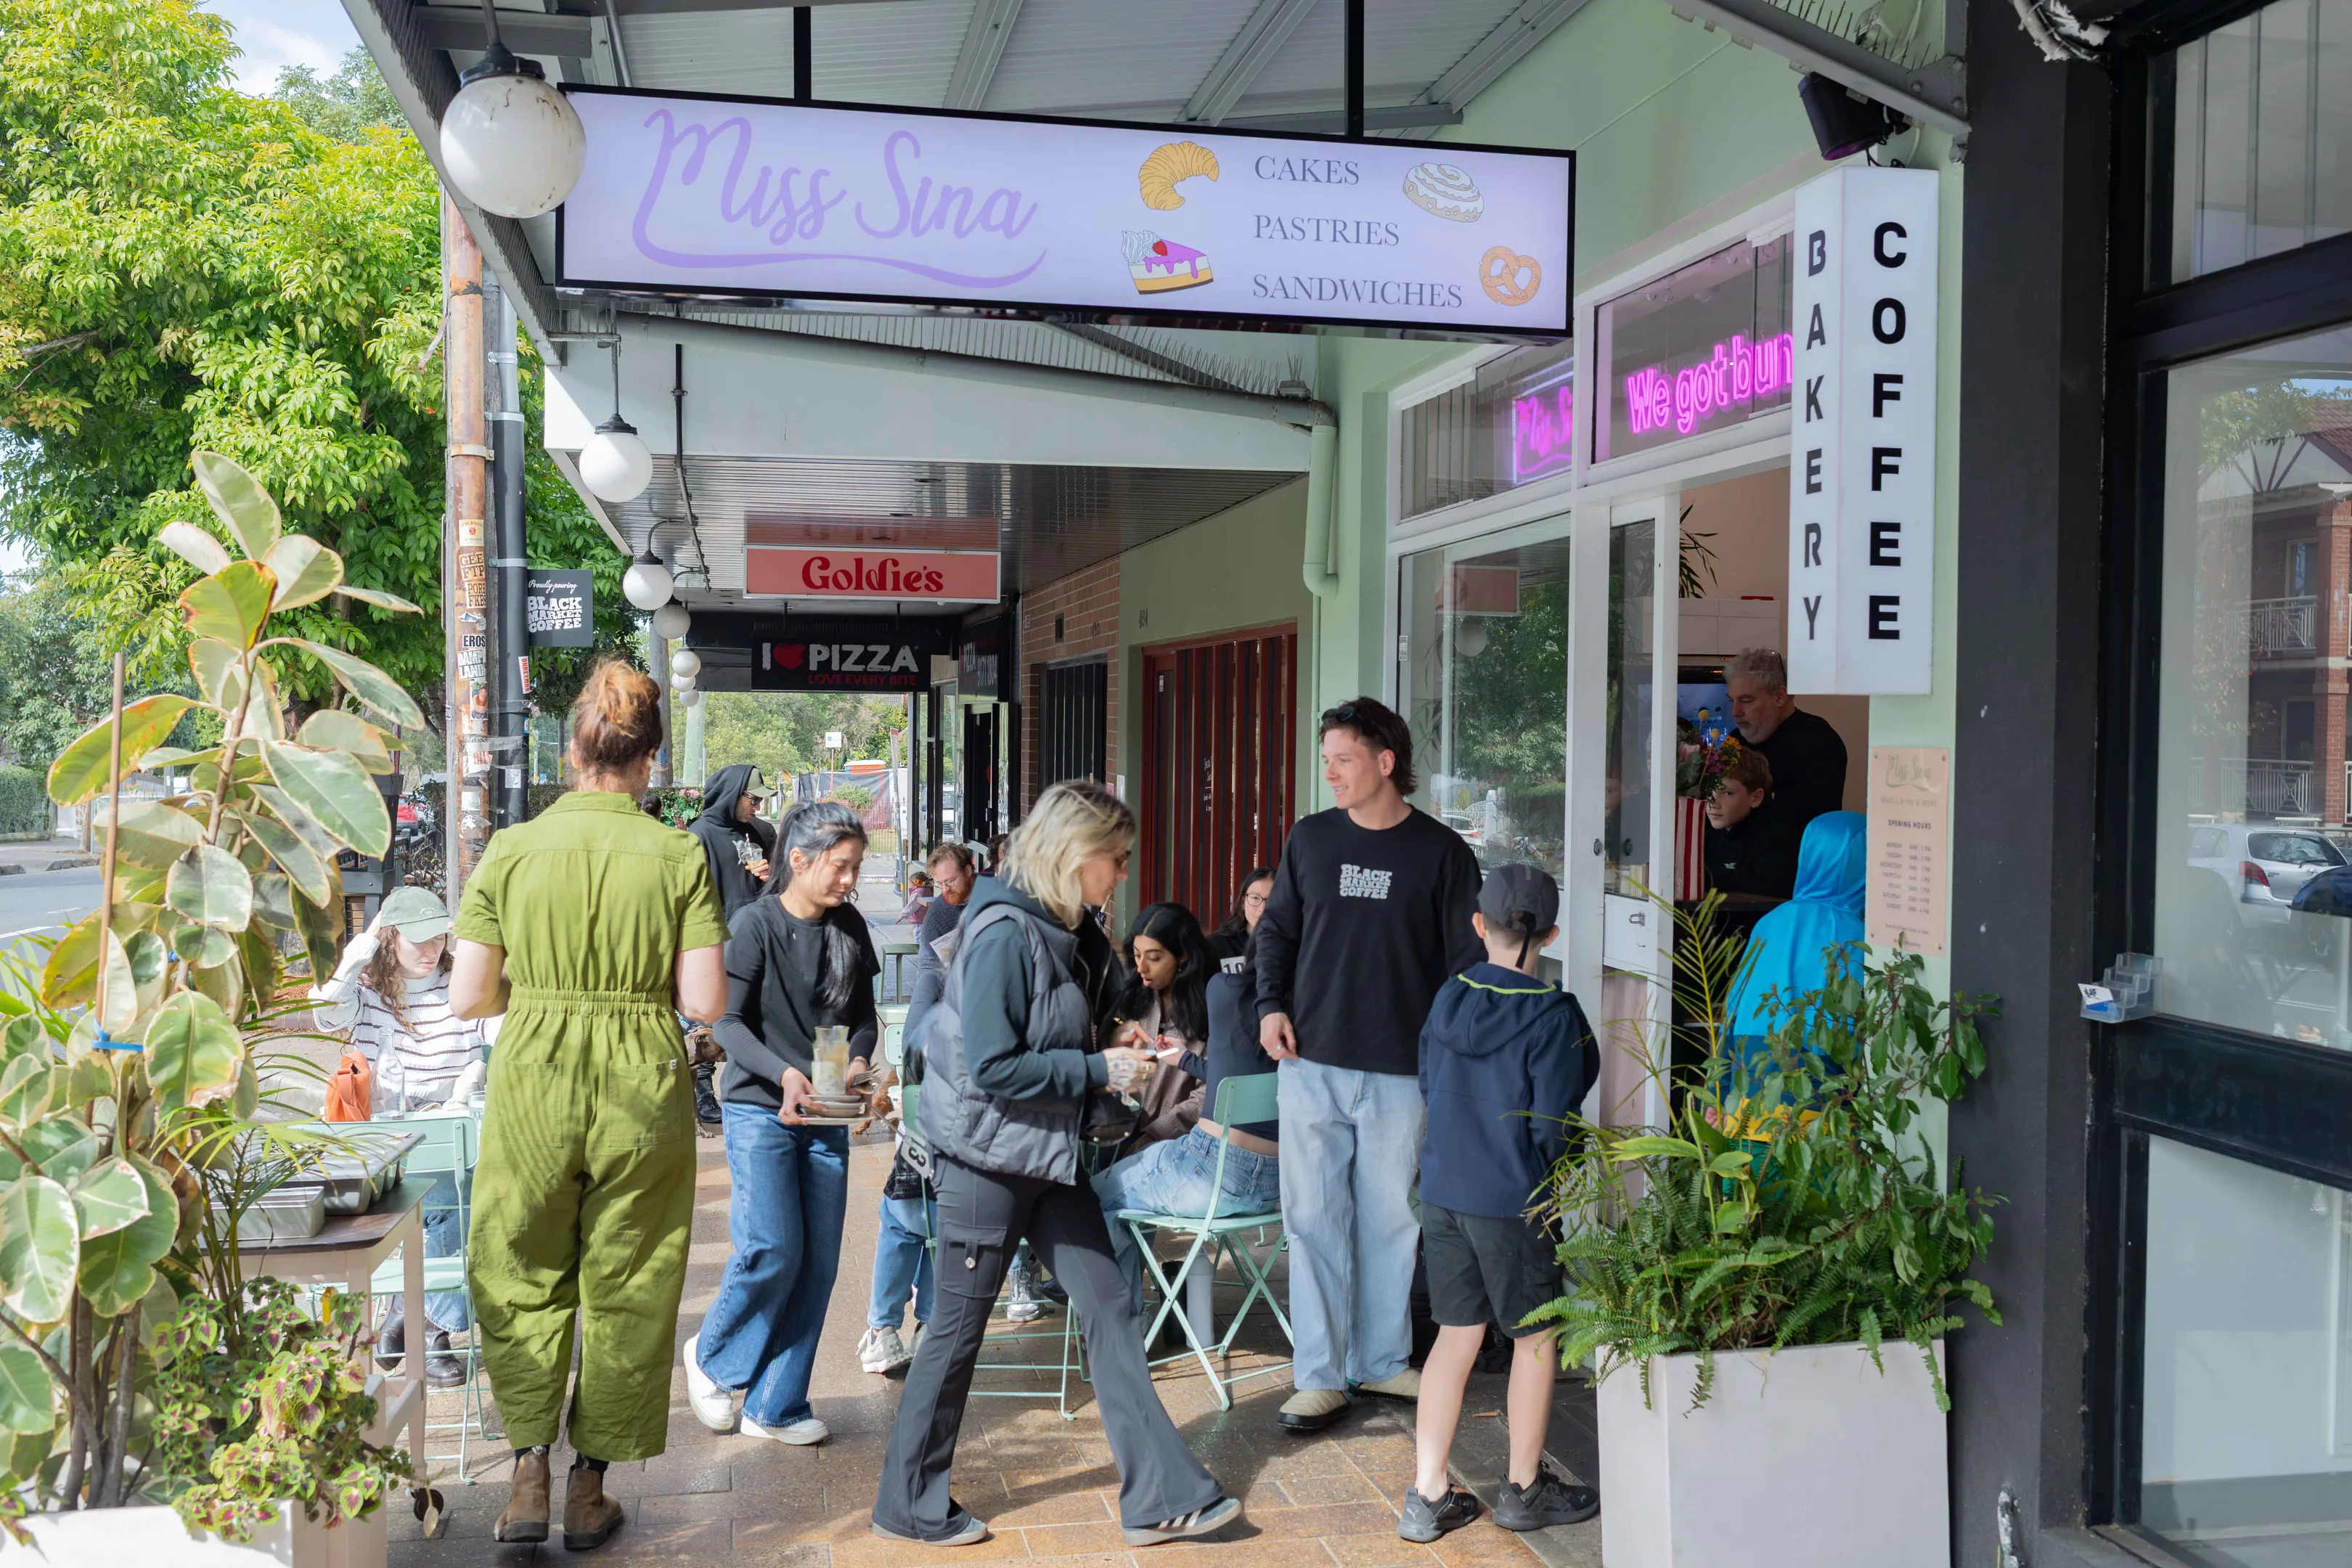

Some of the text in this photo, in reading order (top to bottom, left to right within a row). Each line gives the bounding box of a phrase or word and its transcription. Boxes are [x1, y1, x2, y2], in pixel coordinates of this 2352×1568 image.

[1254, 155, 1359, 185] CAKES
[632, 108, 1038, 268] Miss Sina
[1254, 215, 1399, 246] PASTRIES
[1253, 274, 1461, 308] SANDWICHES
[1627, 367, 1670, 433] We
[1675, 344, 1730, 434] got
[1802, 230, 1826, 640] BAKERY
[1868, 221, 1907, 640] COFFEE
[462, 565, 484, 579] FTP
[801, 556, 944, 592] Goldie's
[528, 579, 578, 594] Proudly pouring
[528, 596, 582, 611] BLACK
[528, 609, 582, 624] MARKET
[528, 618, 581, 632] COFFEE
[463, 635, 486, 647] EROS
[762, 642, 918, 672] I PIZZA
[460, 664, 485, 679] LAND
[808, 674, 917, 686] LOVE EVERY BITE
[1341, 864, 1392, 882] BLACK
[1339, 877, 1390, 890] MARKET
[1339, 886, 1388, 899] COFFEE
